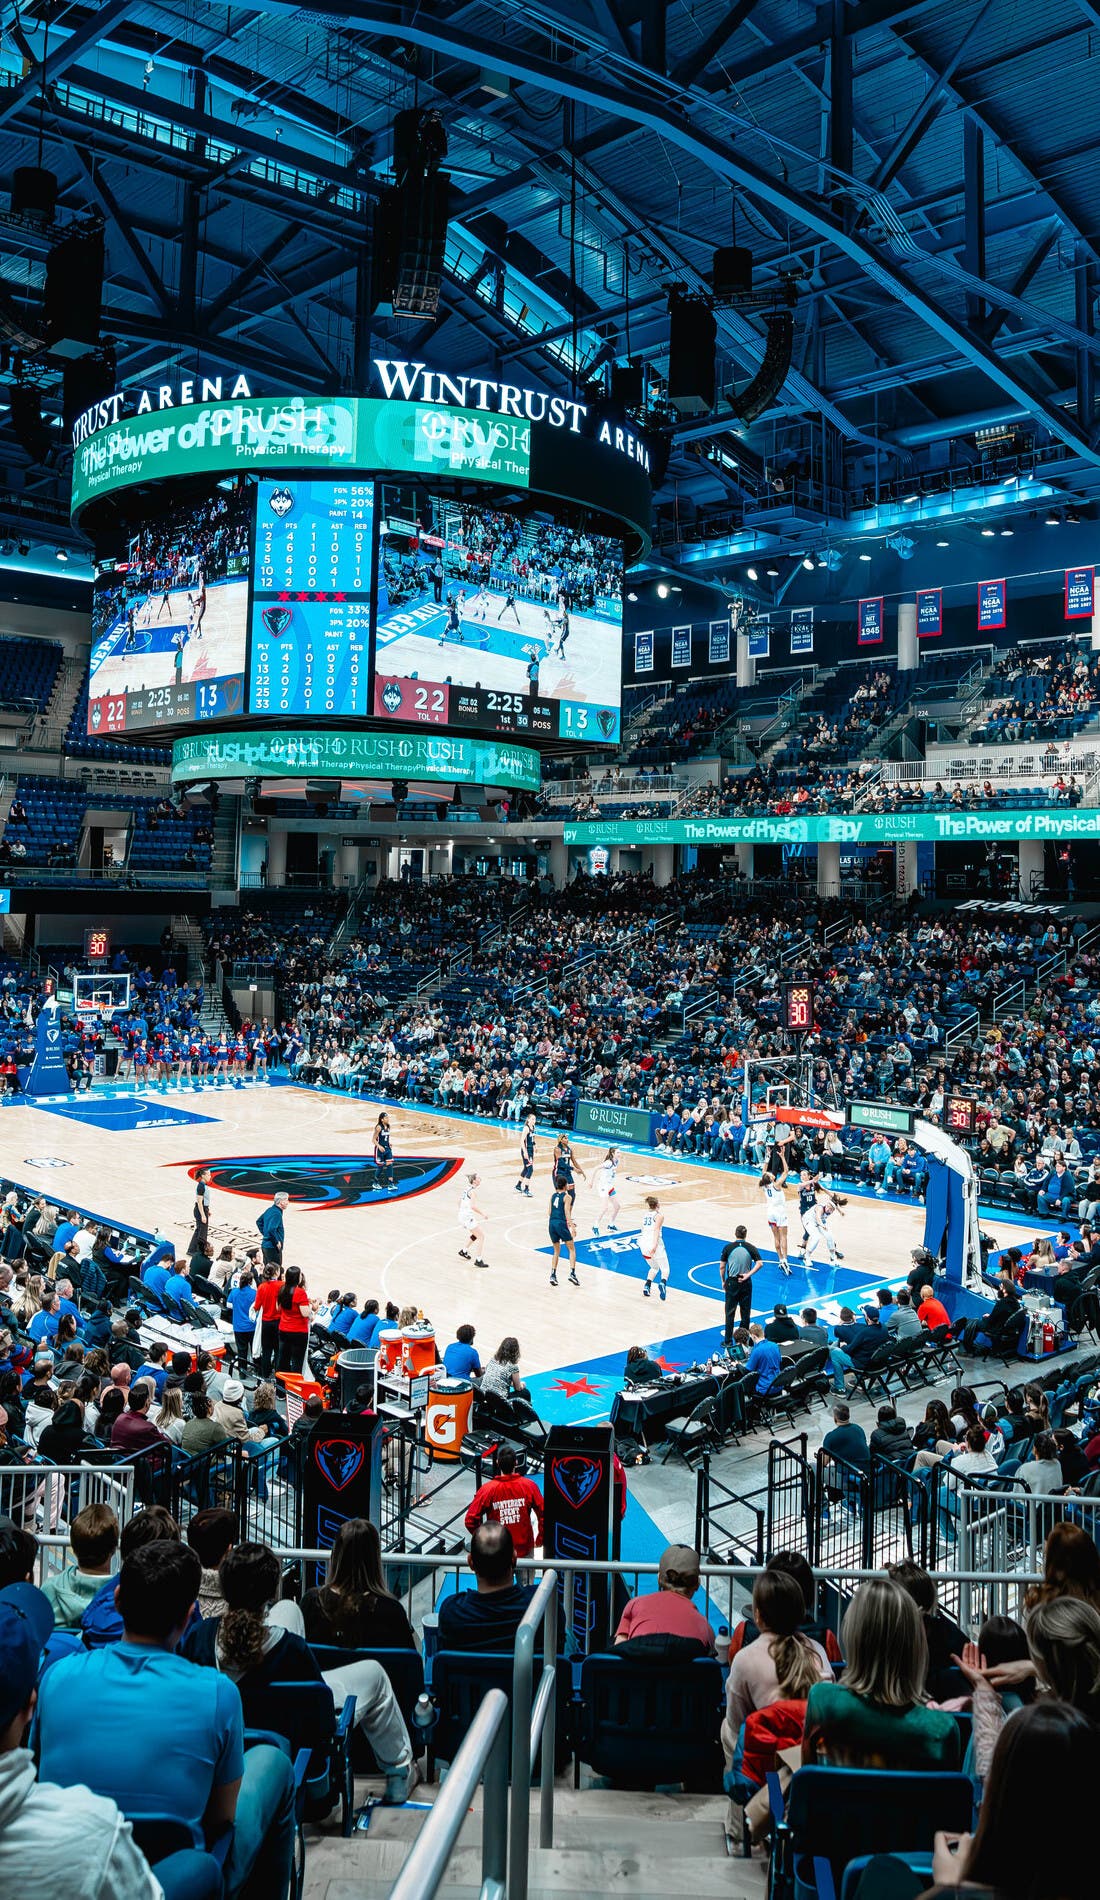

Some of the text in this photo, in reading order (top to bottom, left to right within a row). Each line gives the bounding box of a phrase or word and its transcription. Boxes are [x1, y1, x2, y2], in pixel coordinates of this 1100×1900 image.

[72, 374, 251, 450] TRUST ARENA
[373, 358, 651, 476] WINTRUST ARENA
[451, 452, 501, 469] Physical
[88, 461, 142, 488] Physical Therapy
[351, 487, 373, 495] 56%
[350, 499, 374, 508] 20%
[265, 532, 363, 541] 2 4 1 1 0
[265, 543, 362, 552] 3 6 1 0 5
[264, 555, 271, 564] 5
[286, 555, 293, 564] 6
[309, 555, 316, 564] 0
[331, 555, 338, 564] 0
[261, 566, 360, 575] 10 4 0 4 1
[261, 578, 361, 587] 12 2 0 1 0
[348, 605, 369, 614] 33%
[346, 619, 369, 628] 20%
[349, 632, 355, 640] 8
[861, 627, 880, 635] 1945
[260, 653, 358, 662] 0 4 0 0 4
[257, 664, 359, 673] 13 2 1 3 0
[256, 676, 357, 686] 22 0 2 0 3
[148, 688, 170, 707] 2:25
[200, 685, 217, 707] 13
[256, 688, 356, 698] 25 7 0 0 1
[256, 700, 356, 709] 33 0 1 0 1
[414, 688, 445, 712] 22
[487, 693, 523, 713] 2:25
[108, 700, 124, 722] 22
[417, 712, 431, 721] TOL
[501, 714, 528, 725] 1st 30
[565, 707, 587, 729] 13
[533, 721, 551, 730] POSS
[190, 740, 219, 757] RUSH
[288, 738, 334, 754] RUSH
[351, 739, 400, 756] RUSH
[417, 742, 464, 760] RUSH
[287, 760, 352, 769] Physical Therapy
[352, 762, 417, 772] Physical Therapy
[416, 764, 474, 775] Physical Therapy
[645, 823, 668, 833] RUSH
[886, 817, 916, 828] RUSH
[935, 811, 1100, 836] The Power of Physical
[596, 824, 618, 833] RUSH
[684, 822, 755, 838] The Power of
[91, 942, 104, 954] 30
[792, 990, 808, 1001] 2:25
[792, 1003, 806, 1024] 30
[951, 1100, 971, 1112] 2:25
[600, 1109, 627, 1126] RUSH
[869, 1109, 892, 1120] RUSH
[953, 1112, 966, 1126] 30
[616, 1129, 633, 1138] Therapy
[553, 1197, 559, 1208] 4
[644, 1217, 653, 1225] 33
[427, 1404, 456, 1444] G
[500, 1508, 519, 1516] EVENT
[500, 1515, 520, 1525] STAFF
